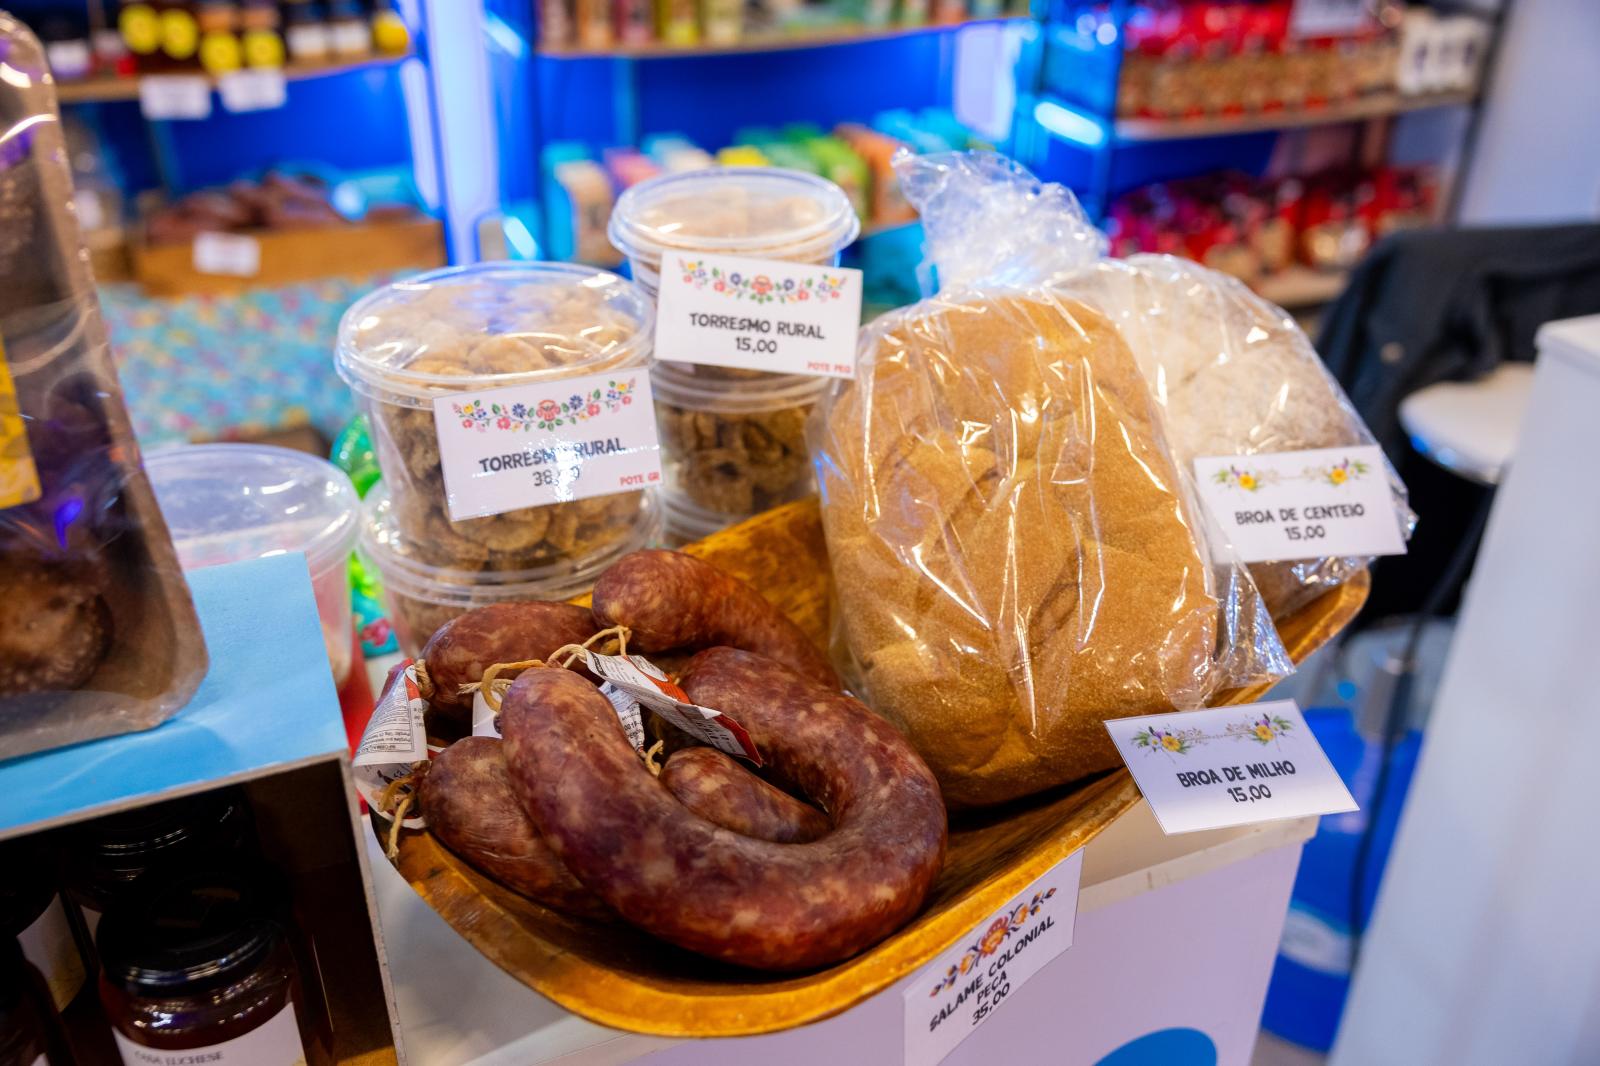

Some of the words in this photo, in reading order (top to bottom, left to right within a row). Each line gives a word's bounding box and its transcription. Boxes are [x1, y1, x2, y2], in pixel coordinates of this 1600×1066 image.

[690, 313, 770, 333] TORRESMO
[777, 321, 825, 339] RURAL
[736, 337, 777, 354] 15,00
[479, 447, 568, 473] TORRESM
[575, 438, 626, 459] RURAL
[532, 466, 580, 487] 380
[620, 474, 645, 486] POTE
[648, 472, 659, 482] GR
[1235, 510, 1275, 525] BROA
[1280, 508, 1298, 522] DE
[1304, 503, 1365, 520] CENTEIO
[1285, 526, 1325, 541] 15,00
[1177, 768, 1222, 788] BROA
[1222, 766, 1246, 782] DE
[1249, 760, 1296, 779] MILHO
[1227, 784, 1272, 803] 15,00
[929, 973, 983, 1032] SALAME
[988, 916, 1055, 978] COLONIAL
[972, 982, 1010, 1026] 35,00
